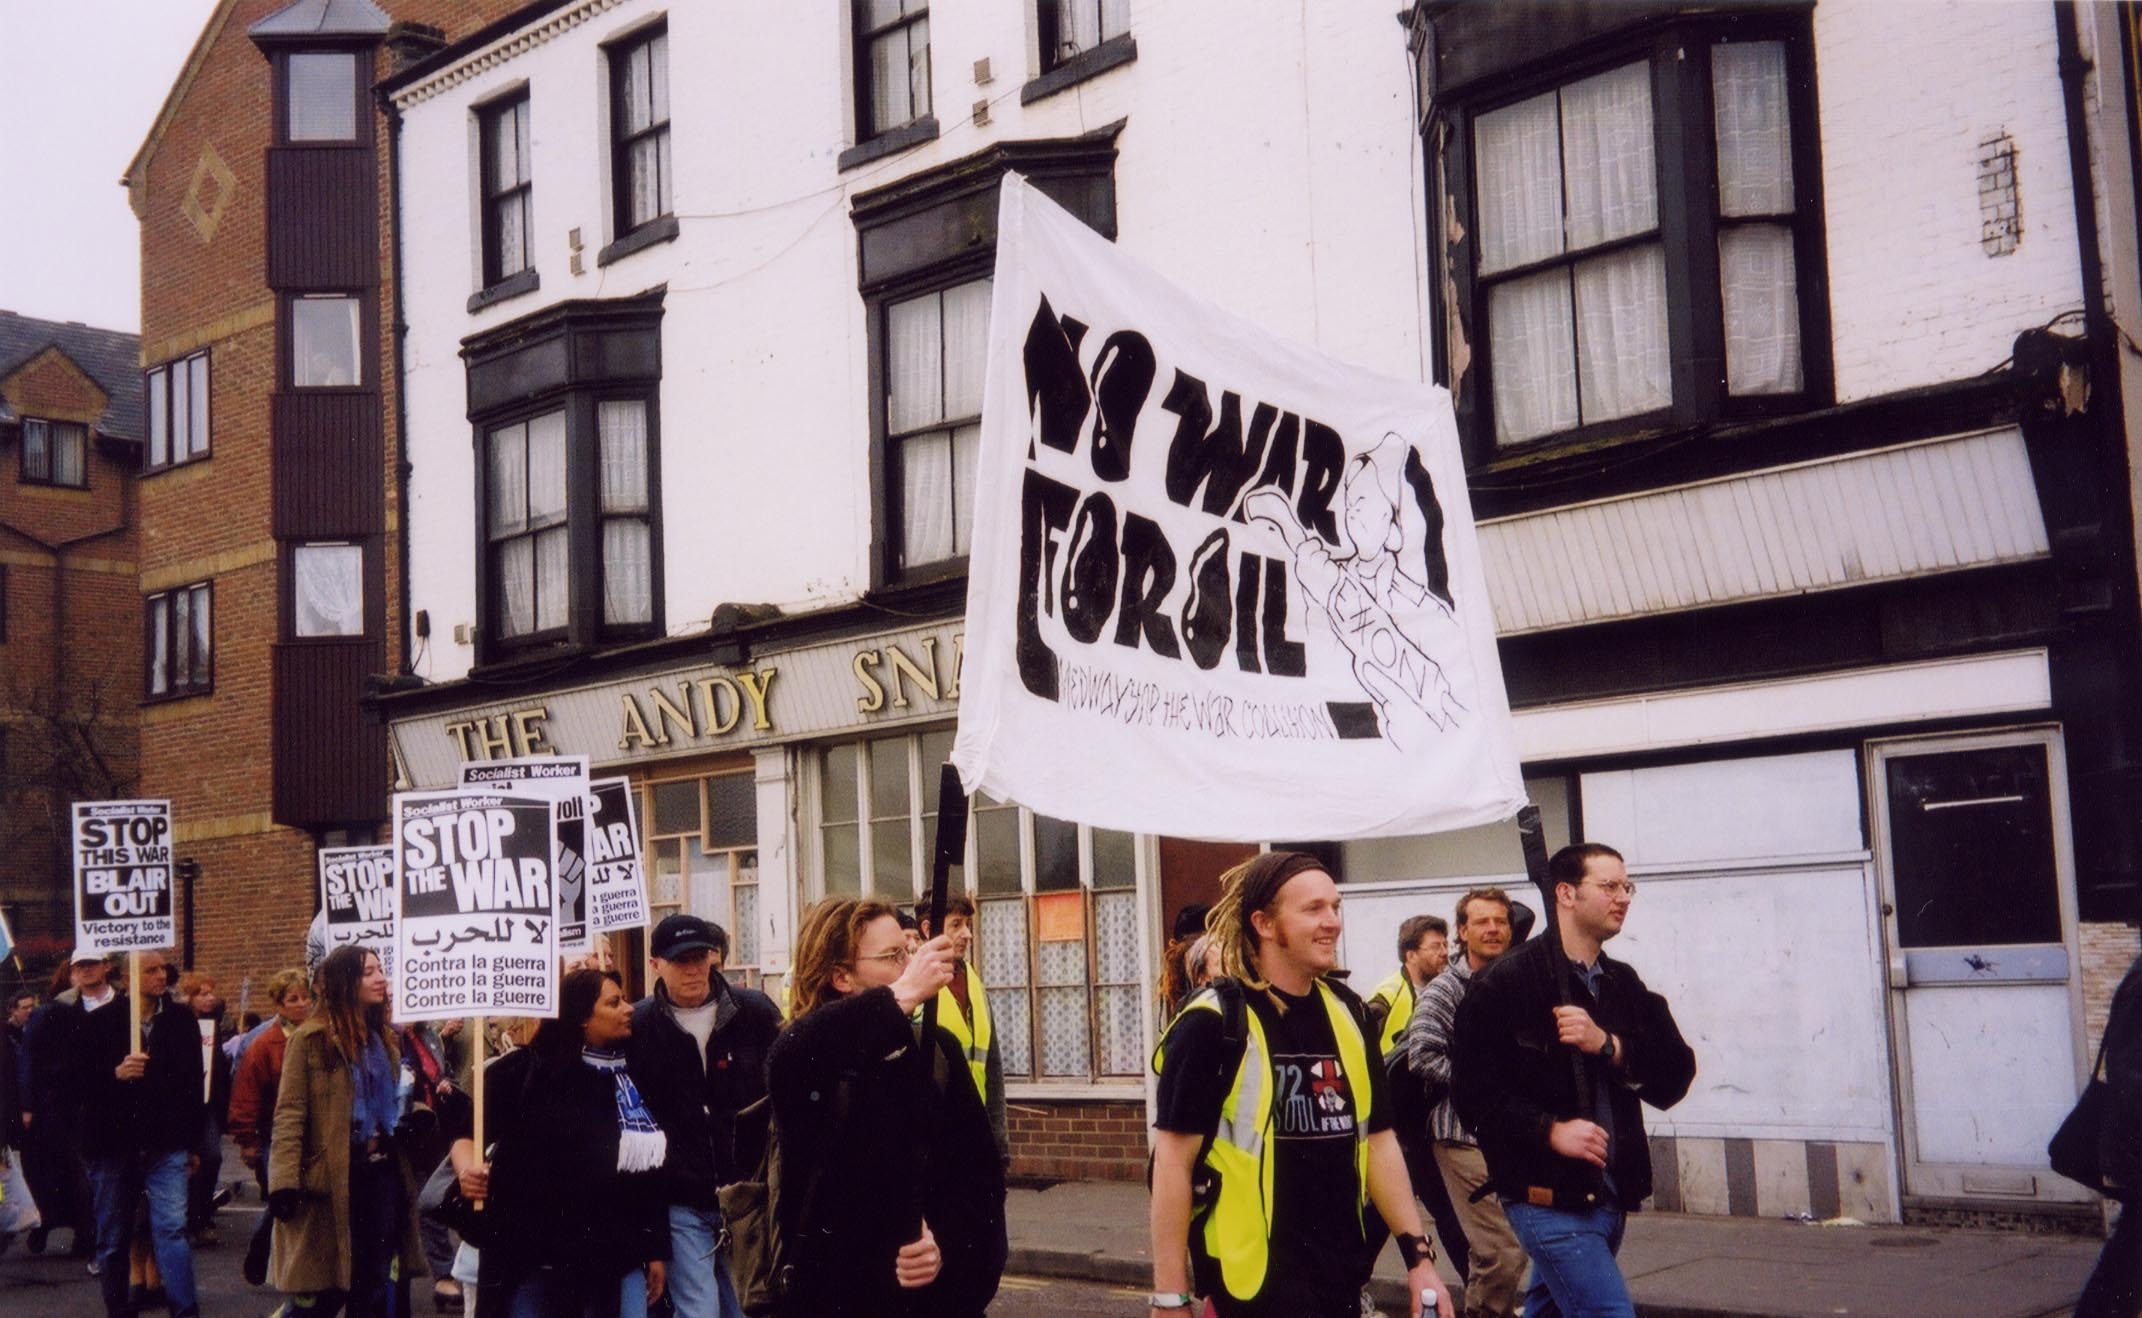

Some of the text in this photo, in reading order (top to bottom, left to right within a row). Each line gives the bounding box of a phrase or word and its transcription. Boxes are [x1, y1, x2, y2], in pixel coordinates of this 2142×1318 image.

[1023, 290, 1345, 547] NO WAR
[1017, 466, 1307, 700] FOR OIL
[446, 706, 556, 762] THE
[618, 668, 777, 749] ANDY
[1163, 691, 1191, 730] THE
[1192, 689, 1238, 737] WAR
[469, 764, 577, 782] Socialist Worker
[403, 796, 503, 818] Socialist Worker
[80, 817, 168, 848] STOP
[403, 809, 516, 870] STOP
[592, 822, 634, 863] AR
[80, 846, 169, 866] THIS WAR
[86, 867, 167, 894] BLAIR
[326, 858, 393, 896] STOP
[405, 866, 447, 896] THE
[450, 857, 550, 914] WAR
[104, 891, 160, 917] OUT
[328, 887, 393, 923] THE WA
[600, 888, 637, 903] guerra
[601, 899, 638, 915] guerra
[82, 918, 171, 936] Victory to the
[603, 910, 640, 926] guerre
[94, 933, 166, 948] resistance
[411, 917, 548, 957] لا للحرب
[405, 957, 466, 974] Contra
[472, 955, 487, 970] la
[493, 957, 546, 973] guerra
[405, 972, 546, 991] Contro la guerra
[405, 990, 546, 1008] Contre la guerre
